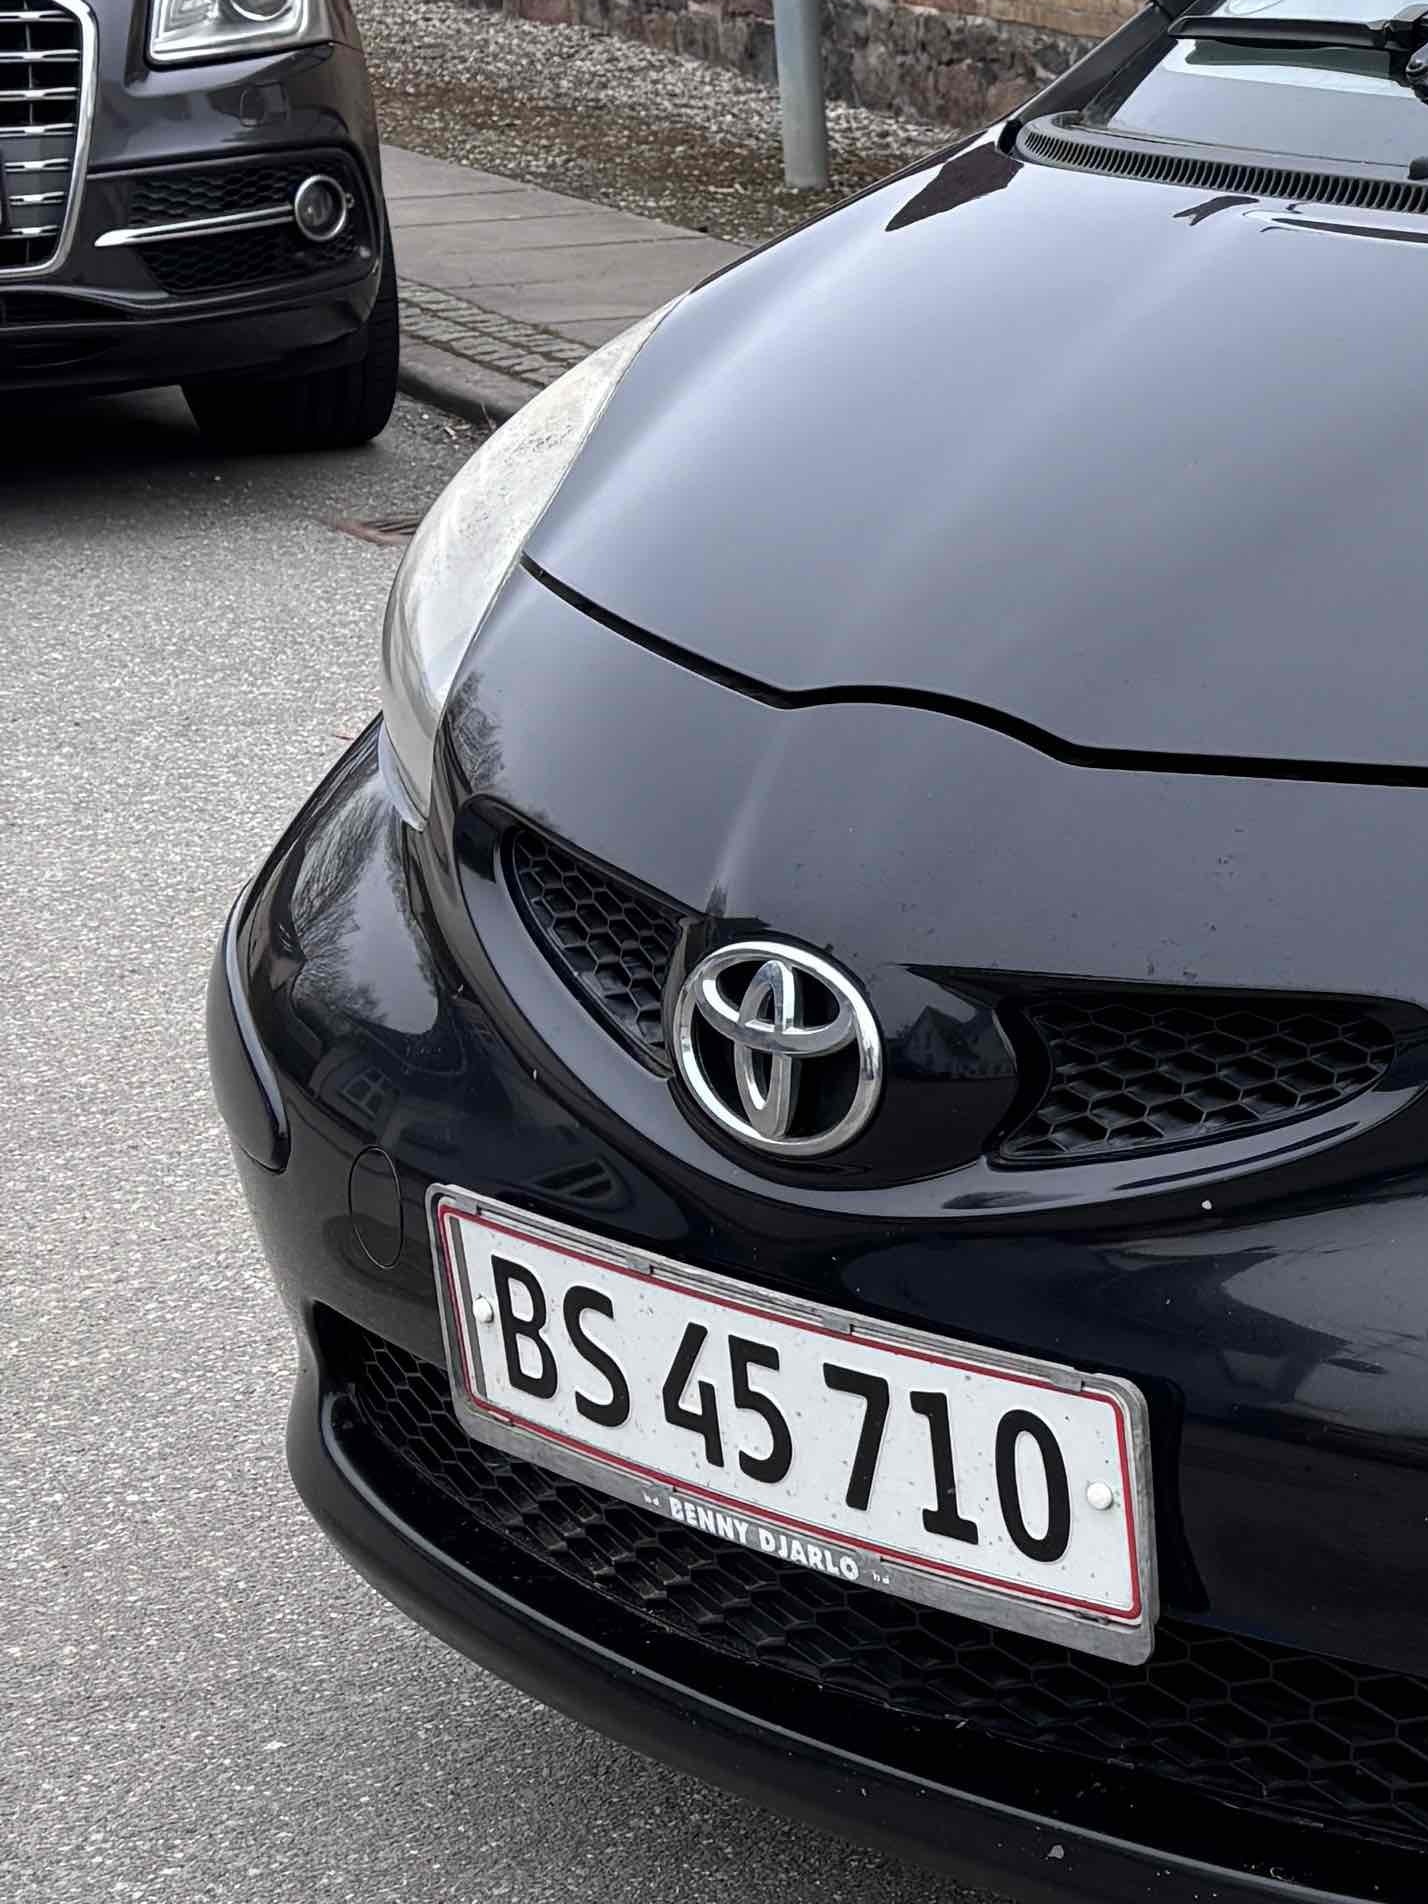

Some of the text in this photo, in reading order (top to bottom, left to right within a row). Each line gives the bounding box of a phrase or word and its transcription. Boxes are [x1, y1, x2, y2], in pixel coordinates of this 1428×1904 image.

[491, 1254, 630, 1427] BS
[669, 1496, 859, 1581] BENNY DJARLO
